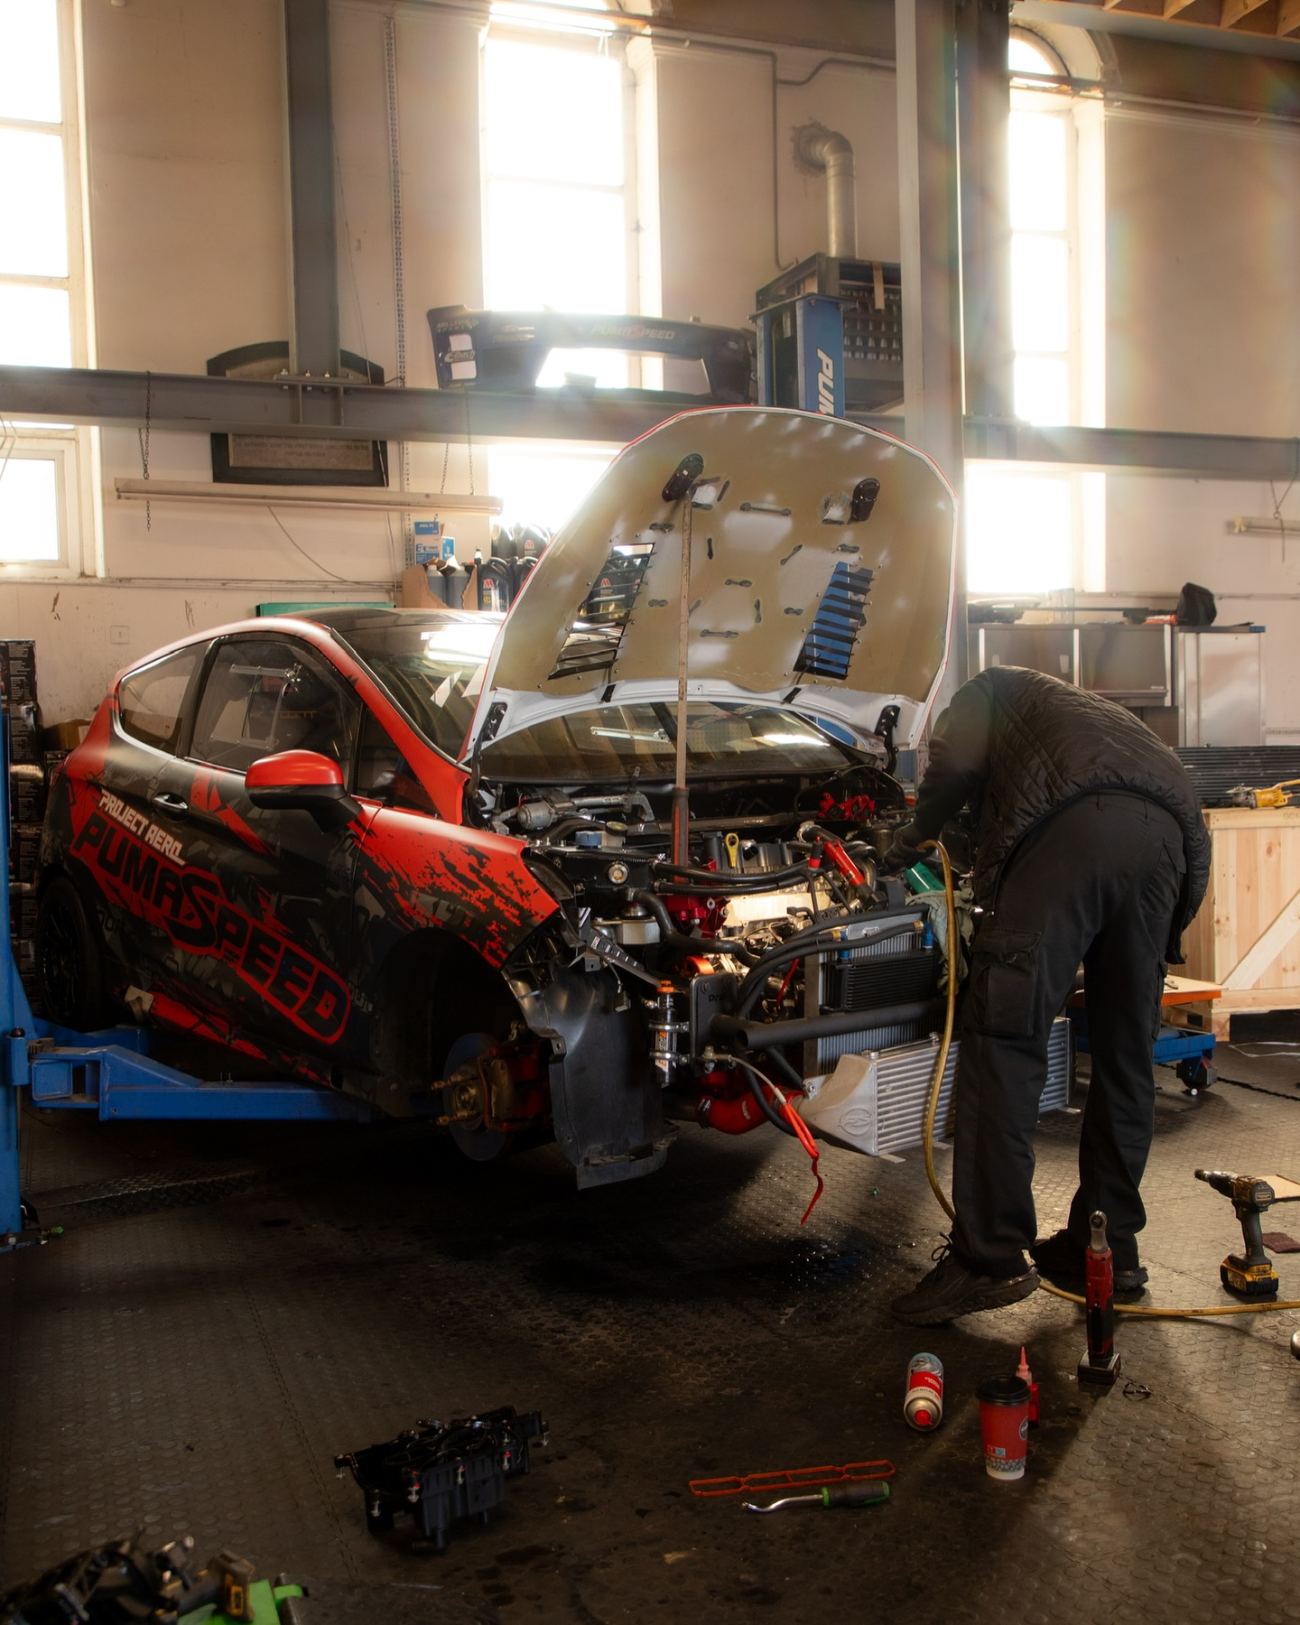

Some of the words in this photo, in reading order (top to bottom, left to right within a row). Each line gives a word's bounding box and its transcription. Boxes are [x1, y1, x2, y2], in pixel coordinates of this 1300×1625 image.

[99, 788, 149, 836] PROJECT
[144, 823, 186, 867] AERO
[73, 813, 349, 1040] PUMASPEED
